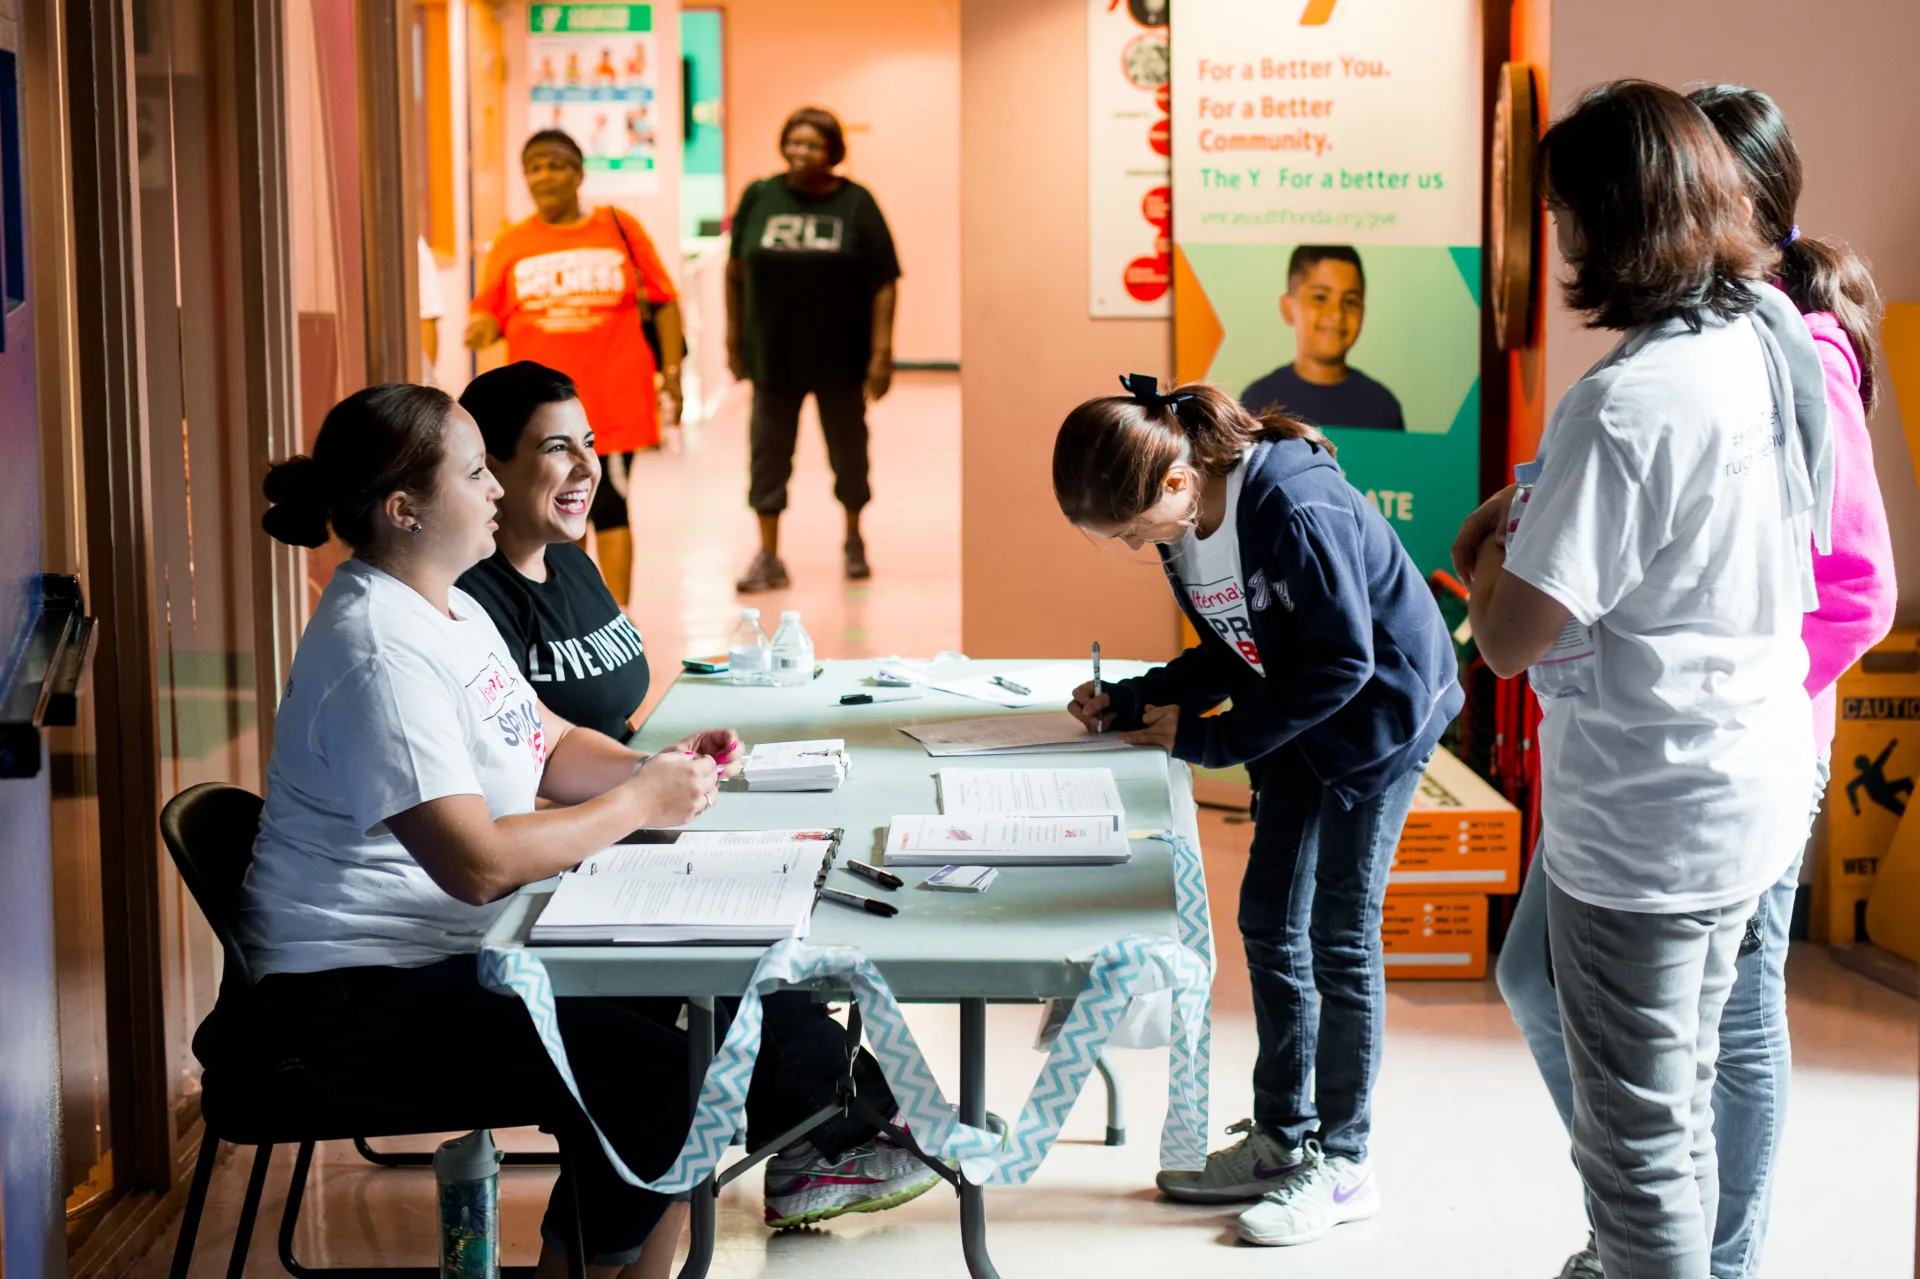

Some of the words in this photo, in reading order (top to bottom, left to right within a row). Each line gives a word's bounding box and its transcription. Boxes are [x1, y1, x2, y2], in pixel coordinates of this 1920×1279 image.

[1198, 58, 1234, 81] For
[1241, 63, 1254, 80] a
[1261, 57, 1332, 80] Better
[1340, 55, 1391, 78] You.
[1198, 97, 1234, 120] For
[1241, 101, 1254, 119] a
[1261, 96, 1335, 119] Better
[1198, 129, 1334, 157] Community.
[1200, 168, 1241, 190] The
[1248, 168, 1261, 188] Y
[1279, 168, 1314, 189] For
[1321, 172, 1333, 189] a
[1340, 168, 1411, 189] better
[529, 638, 603, 682] LIVE
[1844, 857, 1879, 876] WET
